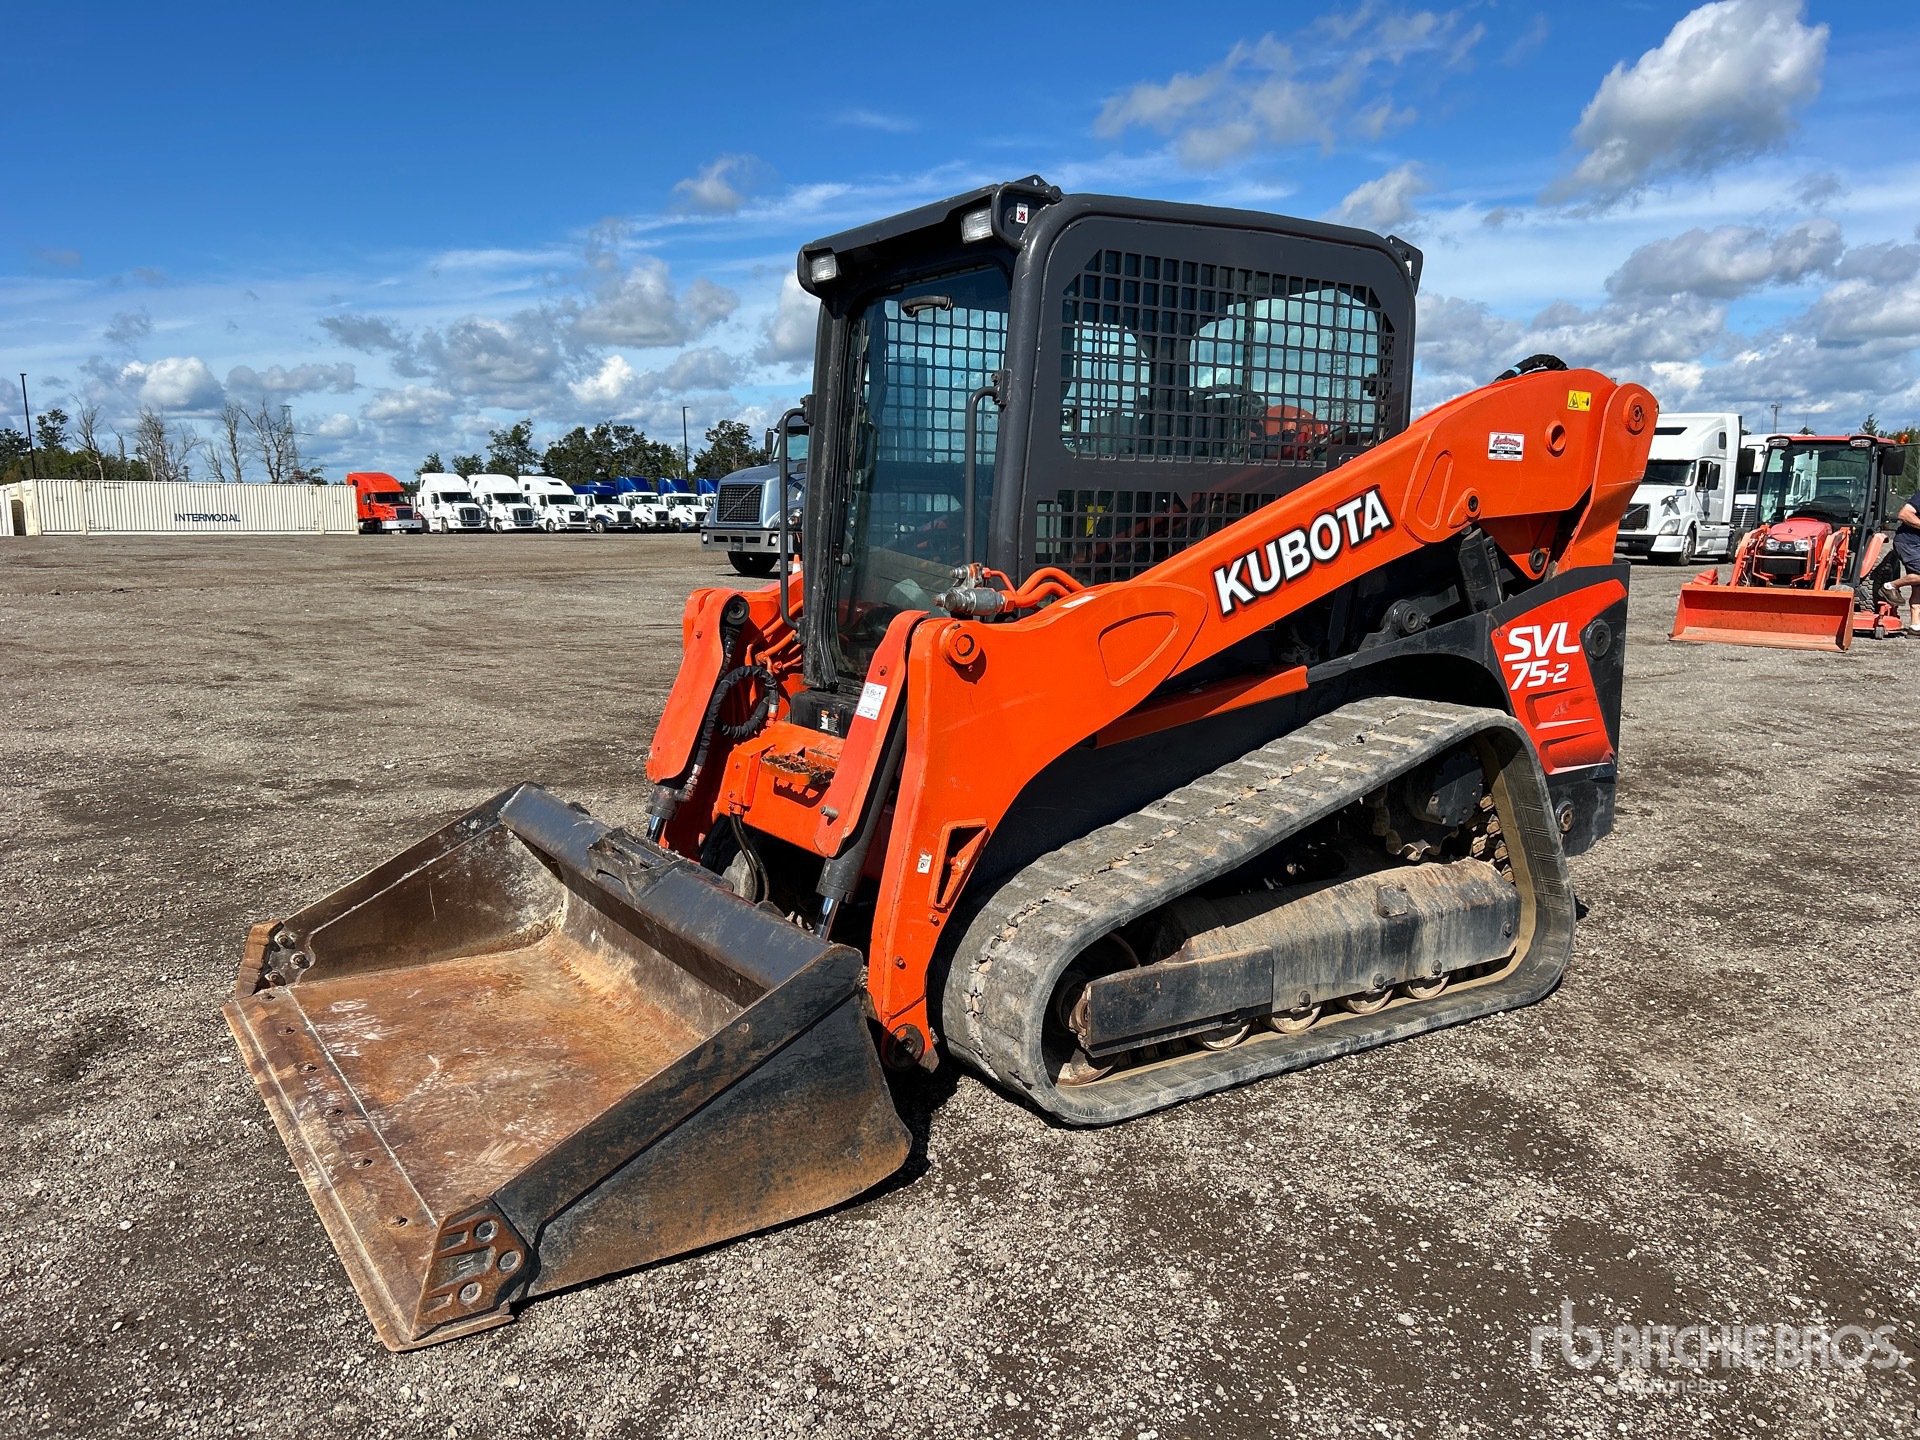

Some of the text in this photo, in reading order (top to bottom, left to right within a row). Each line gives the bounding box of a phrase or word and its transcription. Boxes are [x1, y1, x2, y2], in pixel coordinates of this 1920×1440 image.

[174, 513, 241, 522] INTERMODAL
[1213, 489, 1392, 616] KUBOTA
[1503, 621, 1580, 662] SVL
[1509, 659, 1570, 691] 75-2
